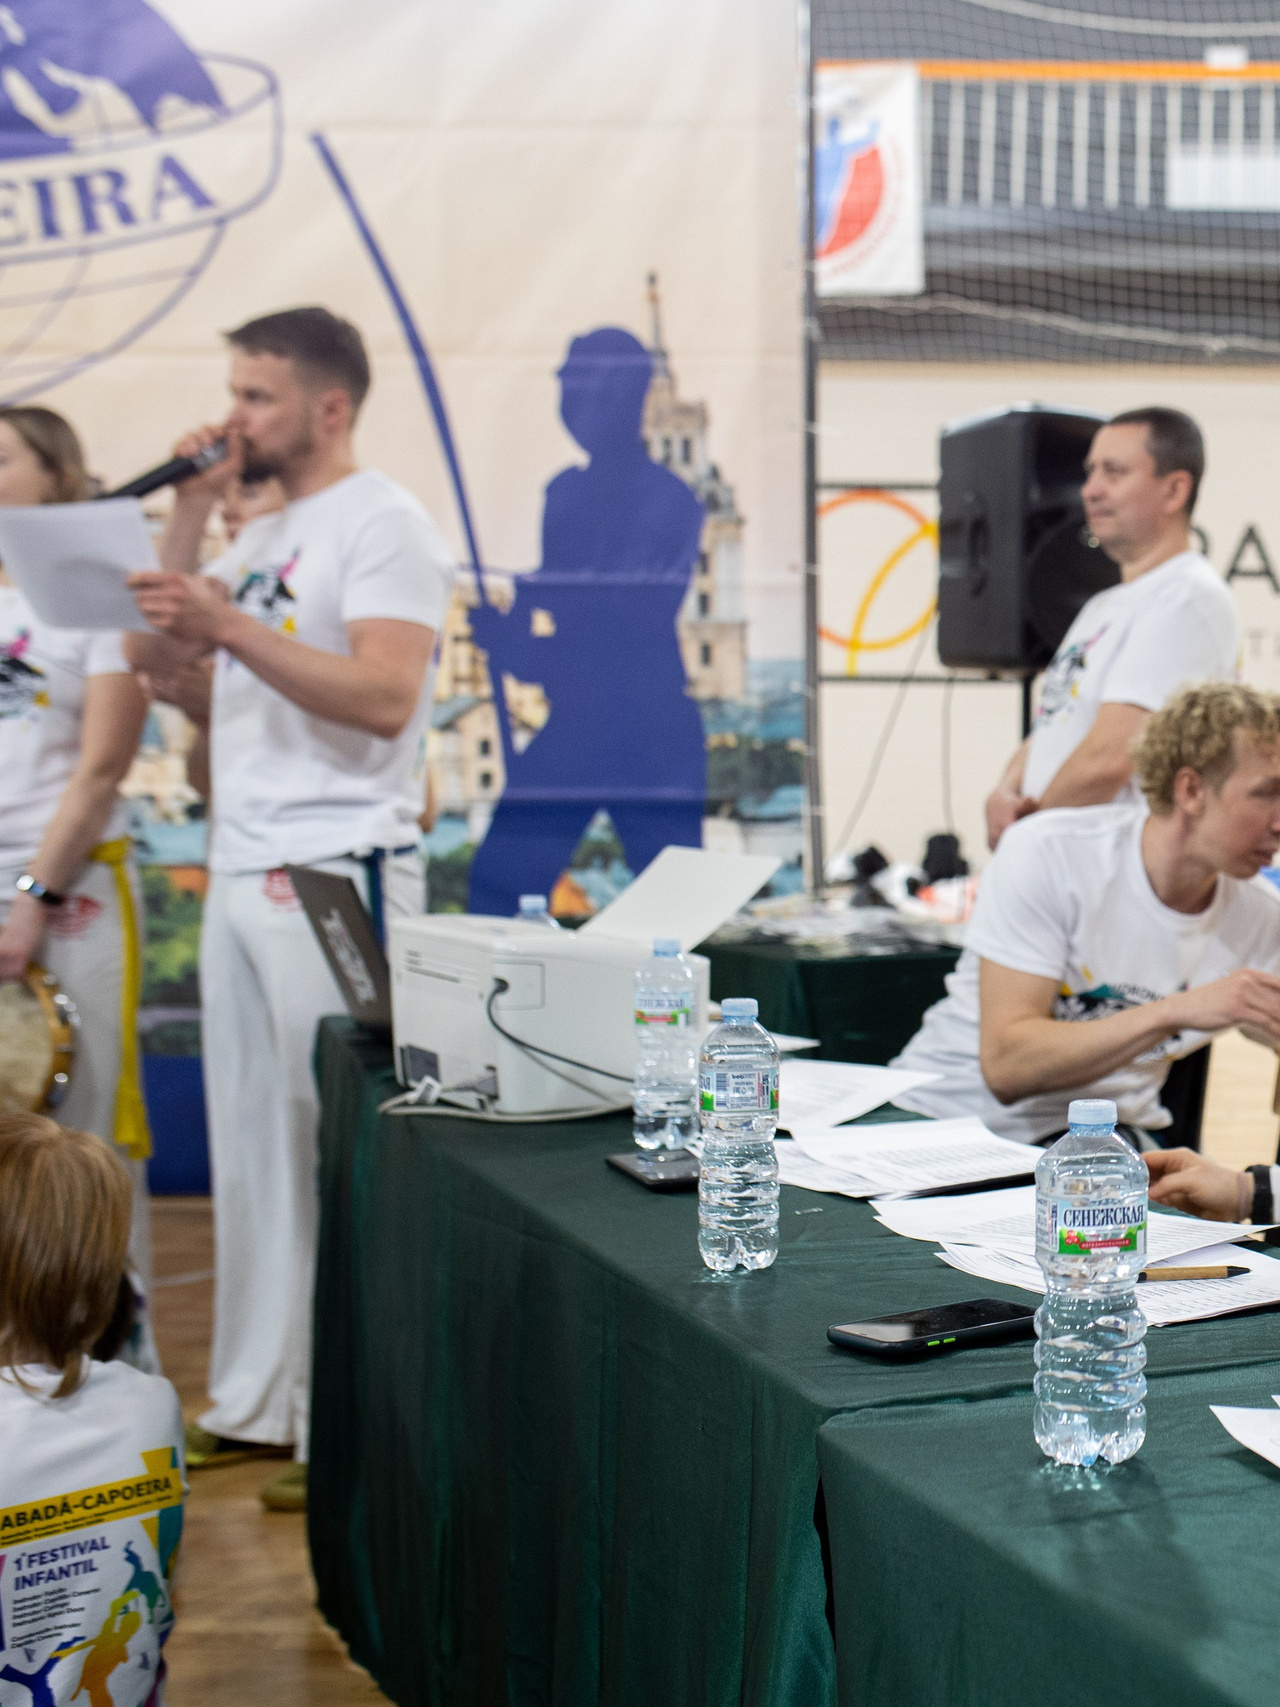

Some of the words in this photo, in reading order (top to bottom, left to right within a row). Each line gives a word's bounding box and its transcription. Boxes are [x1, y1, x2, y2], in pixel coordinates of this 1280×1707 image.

[1063, 1204, 1144, 1228] СЕНЕЖСКАЯ
[0, 1477, 172, 1530] ABADÁ-CAPOEIRA
[28, 1536, 110, 1568] FESTIVAL
[14, 1559, 98, 1591] INFANTIL
